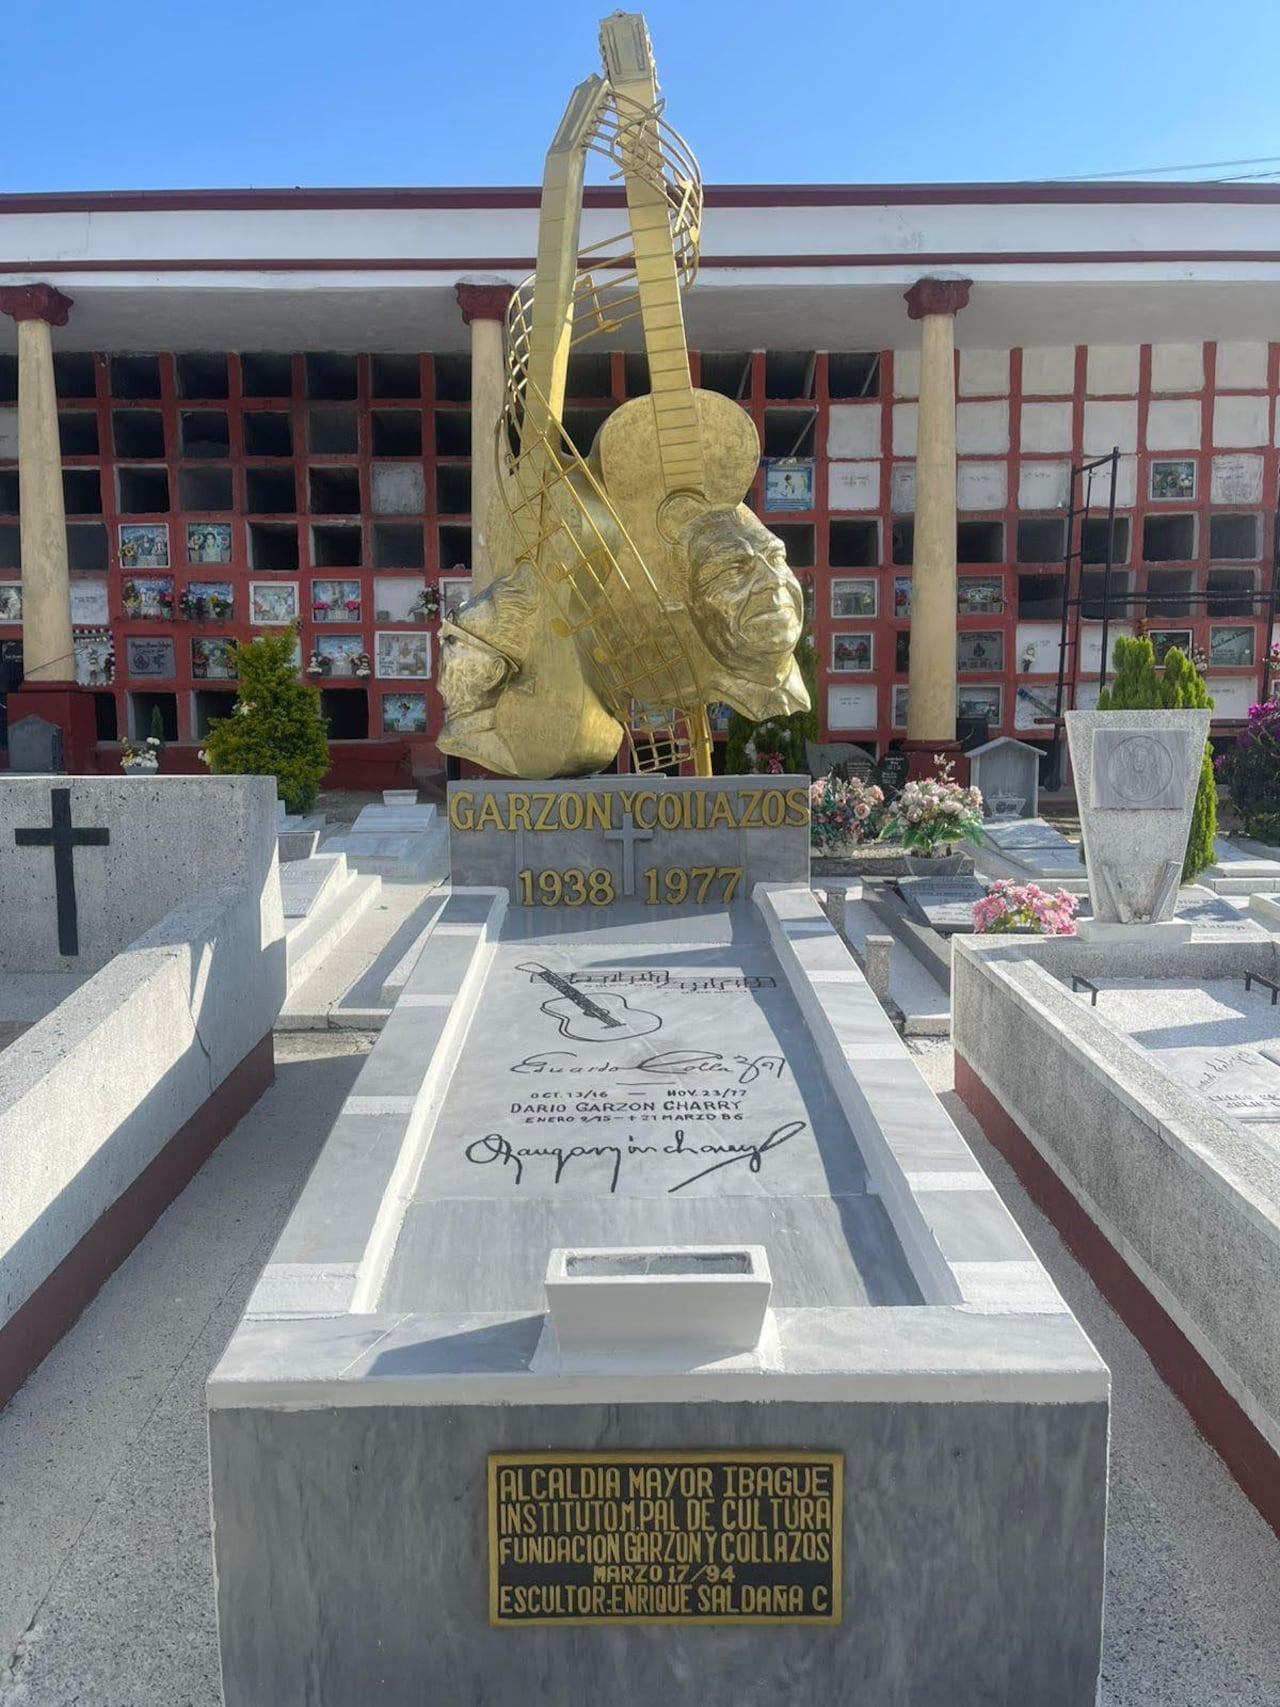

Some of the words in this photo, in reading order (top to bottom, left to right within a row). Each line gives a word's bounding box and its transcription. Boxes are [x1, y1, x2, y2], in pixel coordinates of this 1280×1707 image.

[450, 790, 612, 831] GARZON
[618, 789, 638, 813] Y
[519, 868, 616, 907] 1938
[642, 866, 744, 906] 1977
[510, 1051, 619, 1074] Eduardo
[510, 1102, 567, 1114] DARIO
[576, 1101, 655, 1113] GARZON
[663, 1100, 742, 1111] CHARRY
[525, 1115, 575, 1124] ENERO
[662, 1113, 717, 1121] MARZO
[500, 1467, 621, 1500] ALCALDIA
[629, 1466, 713, 1499] MAYOR
[723, 1466, 830, 1498] IBAGUE
[500, 1501, 617, 1534] INSTITUTO
[687, 1498, 715, 1531] DE
[721, 1498, 831, 1530] CULTURA
[500, 1533, 620, 1565] FUNDACION
[624, 1531, 701, 1564] GARZON
[704, 1531, 718, 1564] Y
[720, 1530, 830, 1563] COLLAZOS
[593, 1565, 663, 1584] MARZO
[698, 1585, 804, 1614] SALDAÑA
[812, 1585, 828, 1612] C
